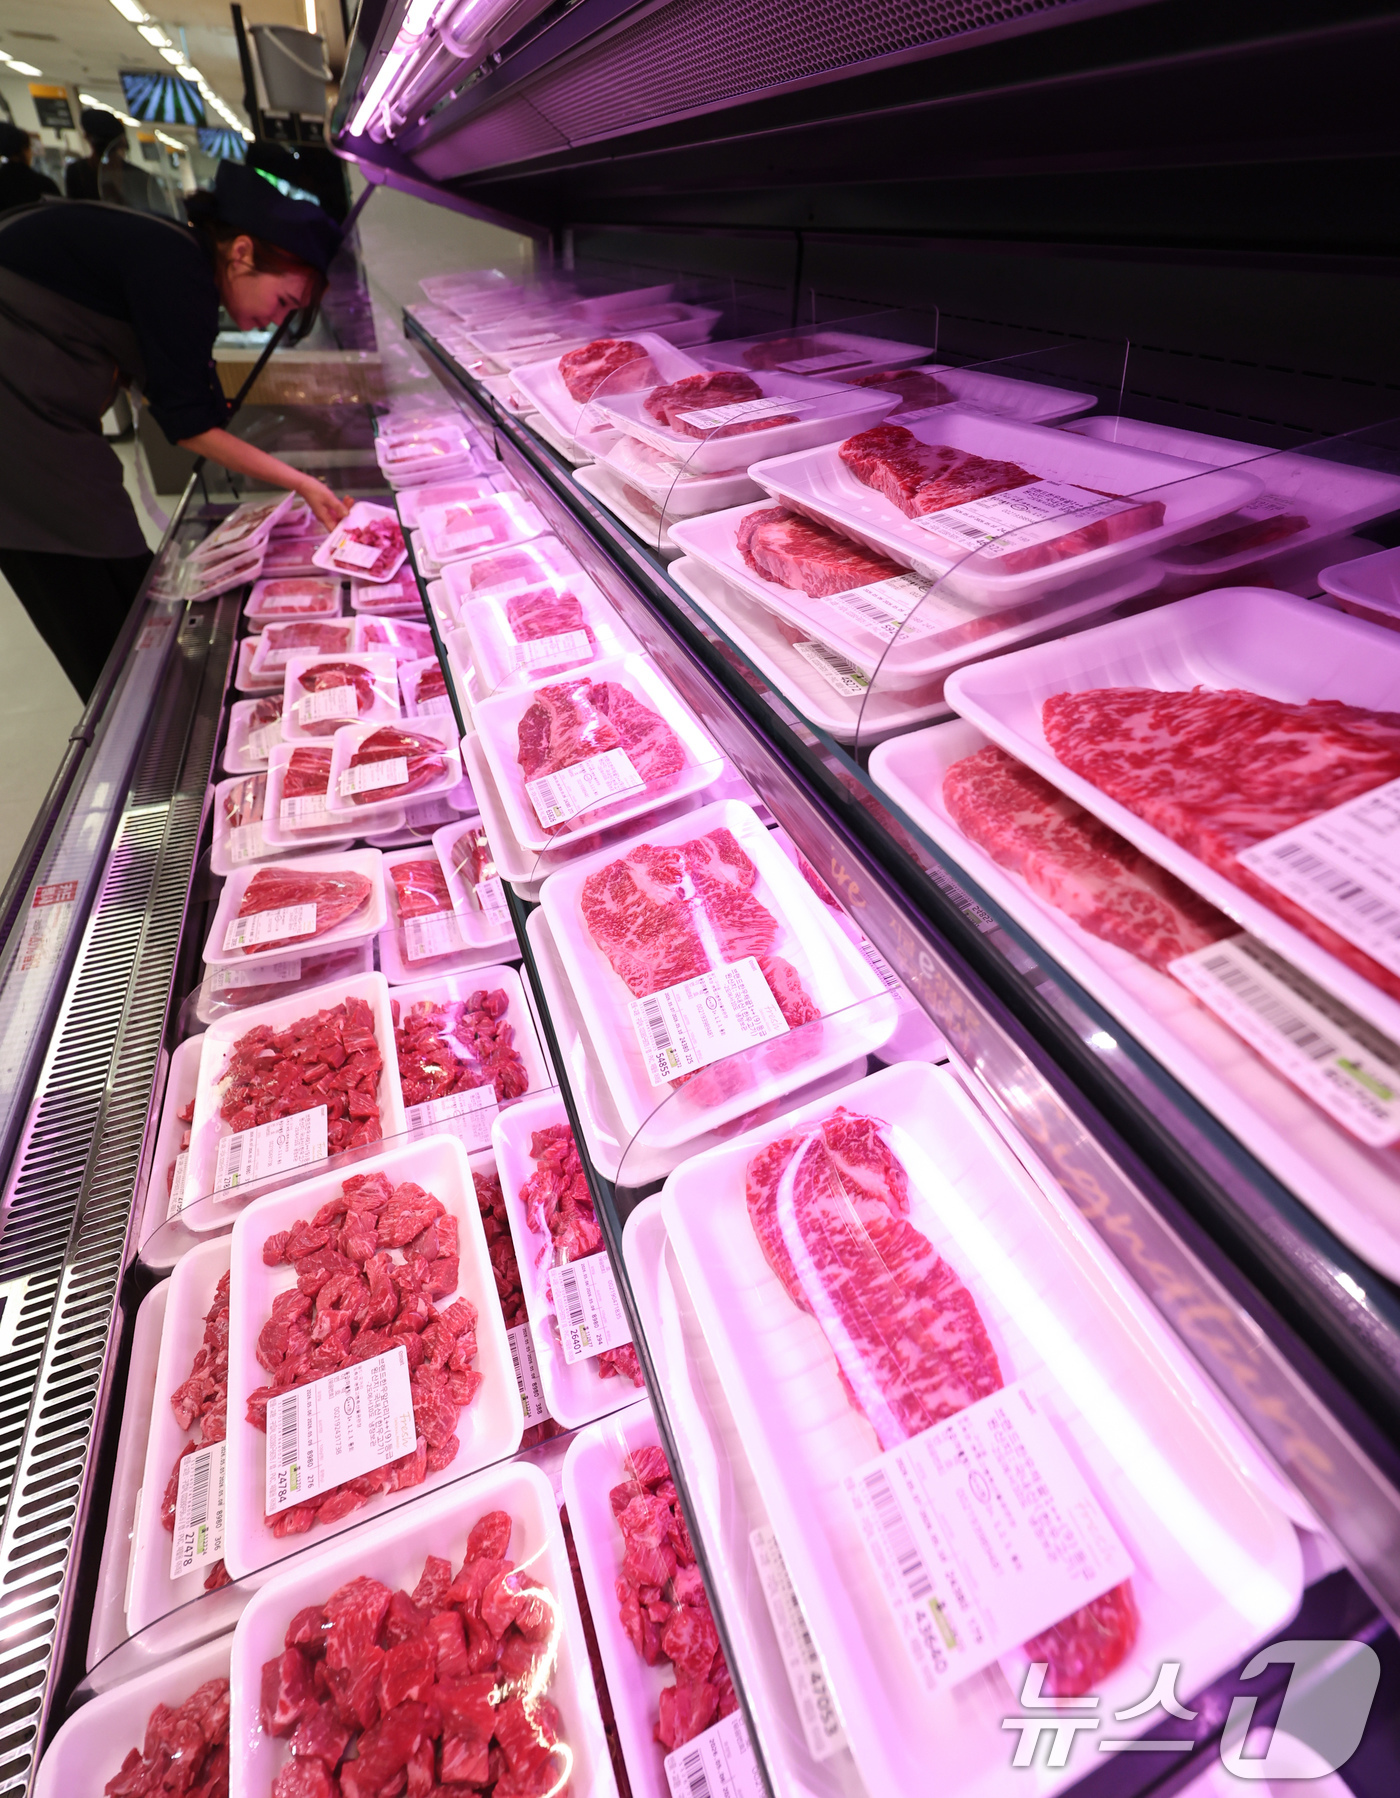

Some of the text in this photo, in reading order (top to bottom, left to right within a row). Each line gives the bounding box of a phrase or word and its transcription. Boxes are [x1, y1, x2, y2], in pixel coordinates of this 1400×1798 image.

[655, 1052, 670, 1077] 54855
[679, 1036, 689, 1053] 24380
[685, 1053, 694, 1064] 225
[591, 1313, 599, 1328] 8980
[570, 1328, 582, 1354] 26401
[531, 1381, 539, 1397] 8980
[333, 1406, 341, 1455] 002192431738
[399, 1410, 413, 1448] Fresh
[278, 1469, 286, 1503] 24784
[182, 1531, 194, 1567] 27478
[911, 1607, 950, 1676] 43640
[807, 1670, 840, 1737] 47053
